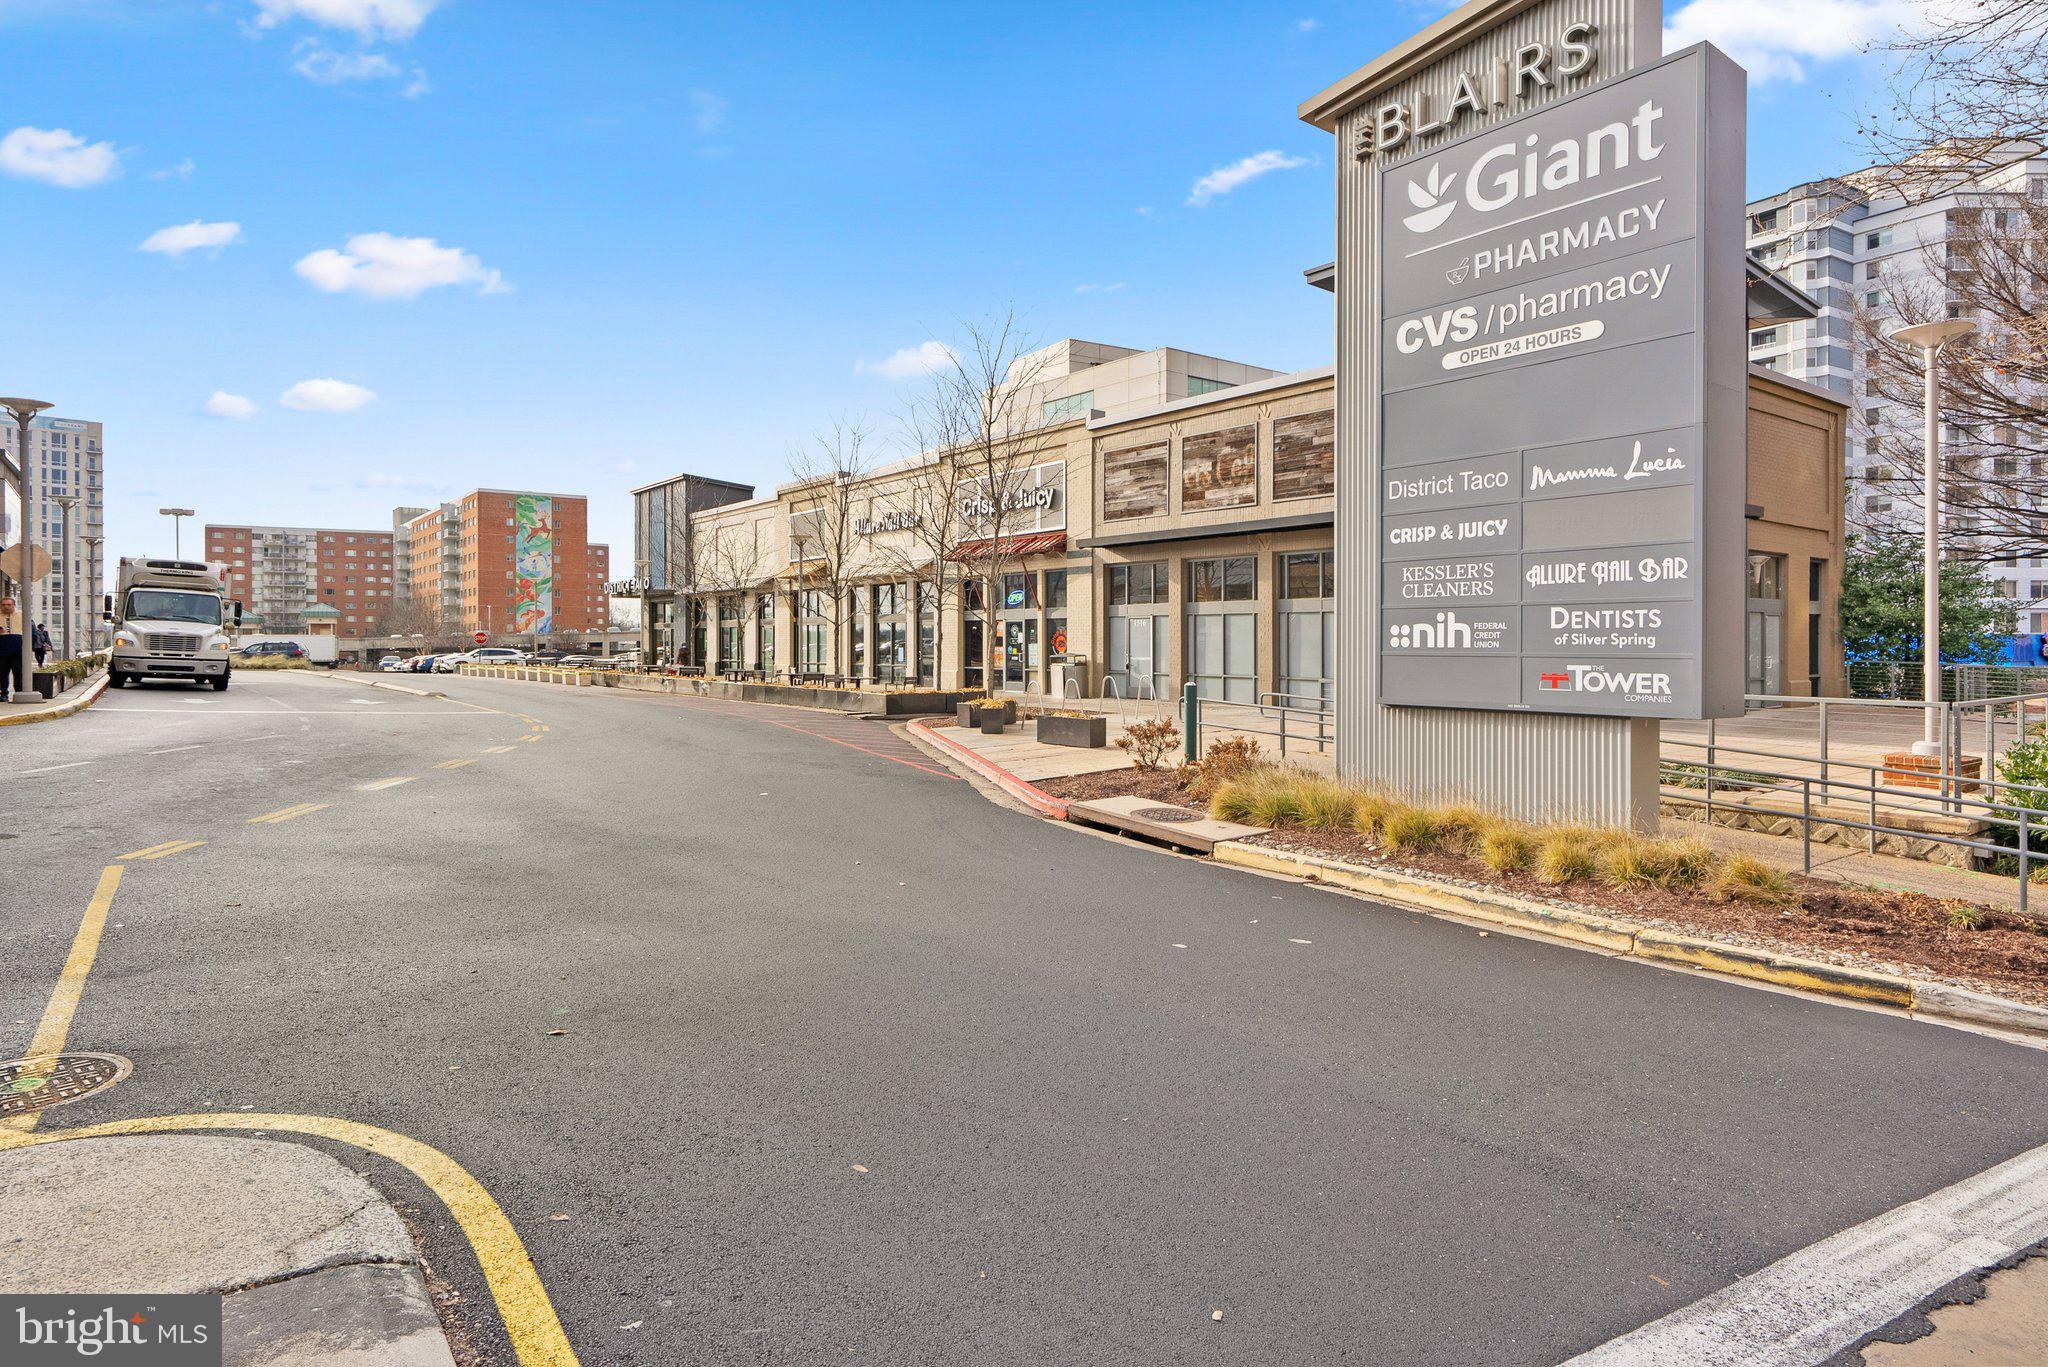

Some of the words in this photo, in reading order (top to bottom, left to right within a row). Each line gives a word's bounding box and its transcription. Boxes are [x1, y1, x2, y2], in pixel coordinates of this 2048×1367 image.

[1378, 22, 1598, 151] BLAIRS
[1465, 100, 1667, 212] Giant
[1473, 198, 1666, 279] PHARMACY
[1459, 344, 1500, 364] OPEN
[1503, 341, 1521, 355] 24
[1525, 327, 1582, 350] HOURS
[1530, 465, 1618, 491] Mamma
[1623, 440, 1686, 481] Lucia
[1015, 486, 1054, 509] Juicy
[1388, 474, 1454, 500] District
[1459, 470, 1509, 491] Taco
[1389, 525, 1436, 545] CRISP
[1440, 523, 1454, 541] &
[1457, 518, 1508, 541] JUICY
[1402, 562, 1495, 582] KESSLER'S
[1525, 562, 1587, 588] ALLURE
[1638, 556, 1689, 583] BAR
[1402, 580, 1494, 599] CLEANERS
[1412, 612, 1471, 649] nih
[1473, 622, 1508, 630] FEDERAL
[1550, 606, 1663, 630] DENTISTS
[1473, 631, 1502, 639] CREDIT
[1473, 640, 1500, 649] UNION
[1554, 633, 1570, 645] of
[1571, 633, 1608, 645] Silver
[1610, 633, 1656, 648] Spring
[1566, 664, 1672, 695] TOWER
[1624, 694, 1672, 704] COMPANIES
